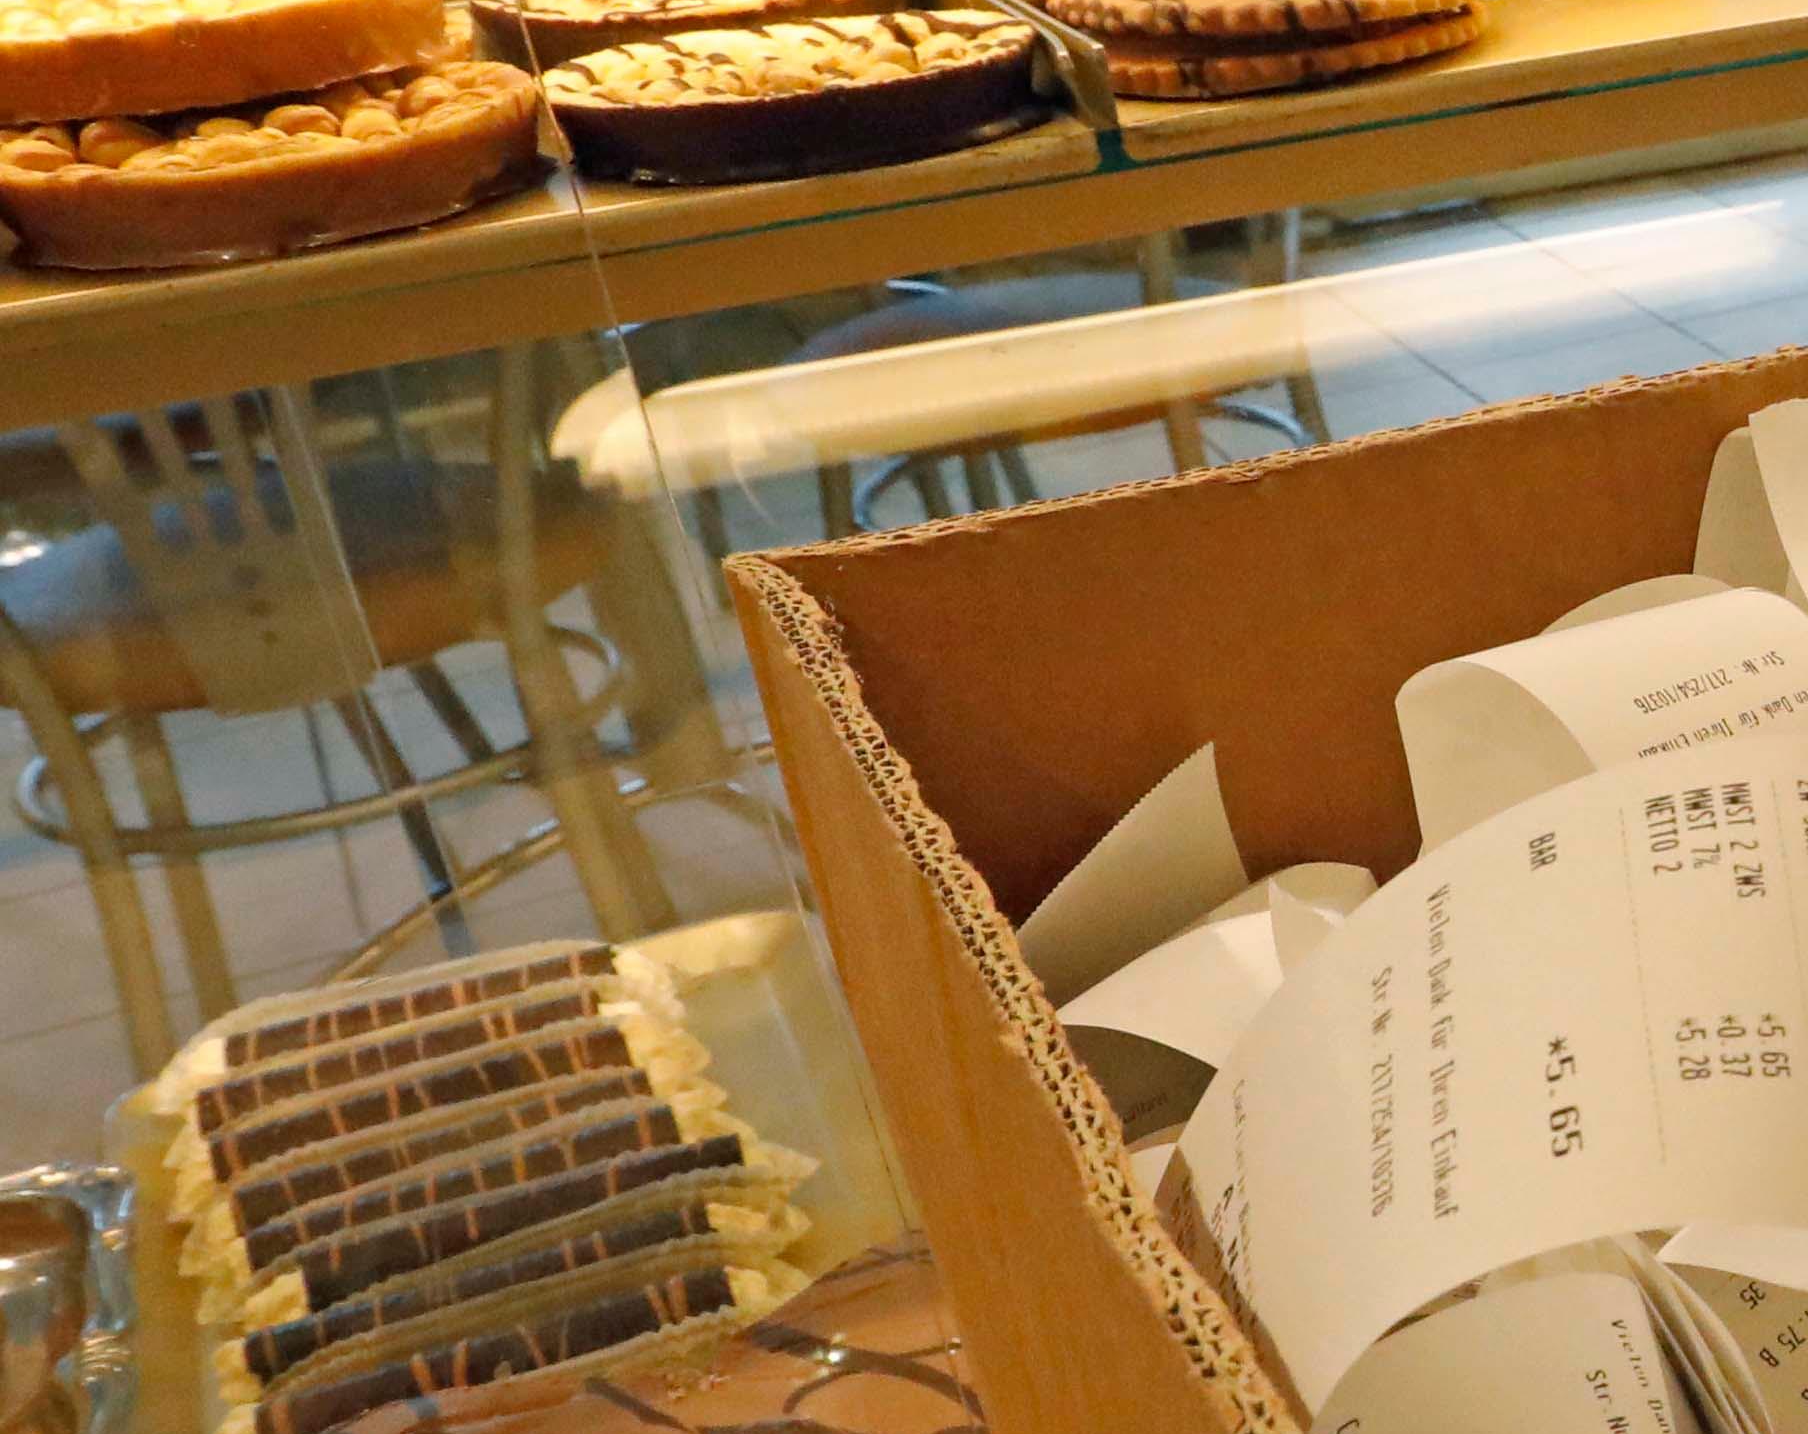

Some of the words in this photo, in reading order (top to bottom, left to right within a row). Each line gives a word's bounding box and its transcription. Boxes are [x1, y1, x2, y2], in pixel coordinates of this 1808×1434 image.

[1633, 666, 1732, 716] 217/254/10376
[1756, 695, 1795, 720] Dank
[1731, 707, 1759, 730] für
[1644, 794, 1680, 851] NETTO
[1721, 781, 1753, 831] MWST
[1528, 832, 1556, 871] BAR
[1426, 883, 1451, 953] Vielen
[1427, 959, 1445, 1007] Dank
[1430, 1015, 1458, 1053] für
[1428, 1058, 1450, 1121] Ihren
[1369, 1053, 1396, 1219] 217/254/10376
[1430, 1127, 1460, 1222] Einkauf
[1611, 1319, 1651, 1389] Vielen
